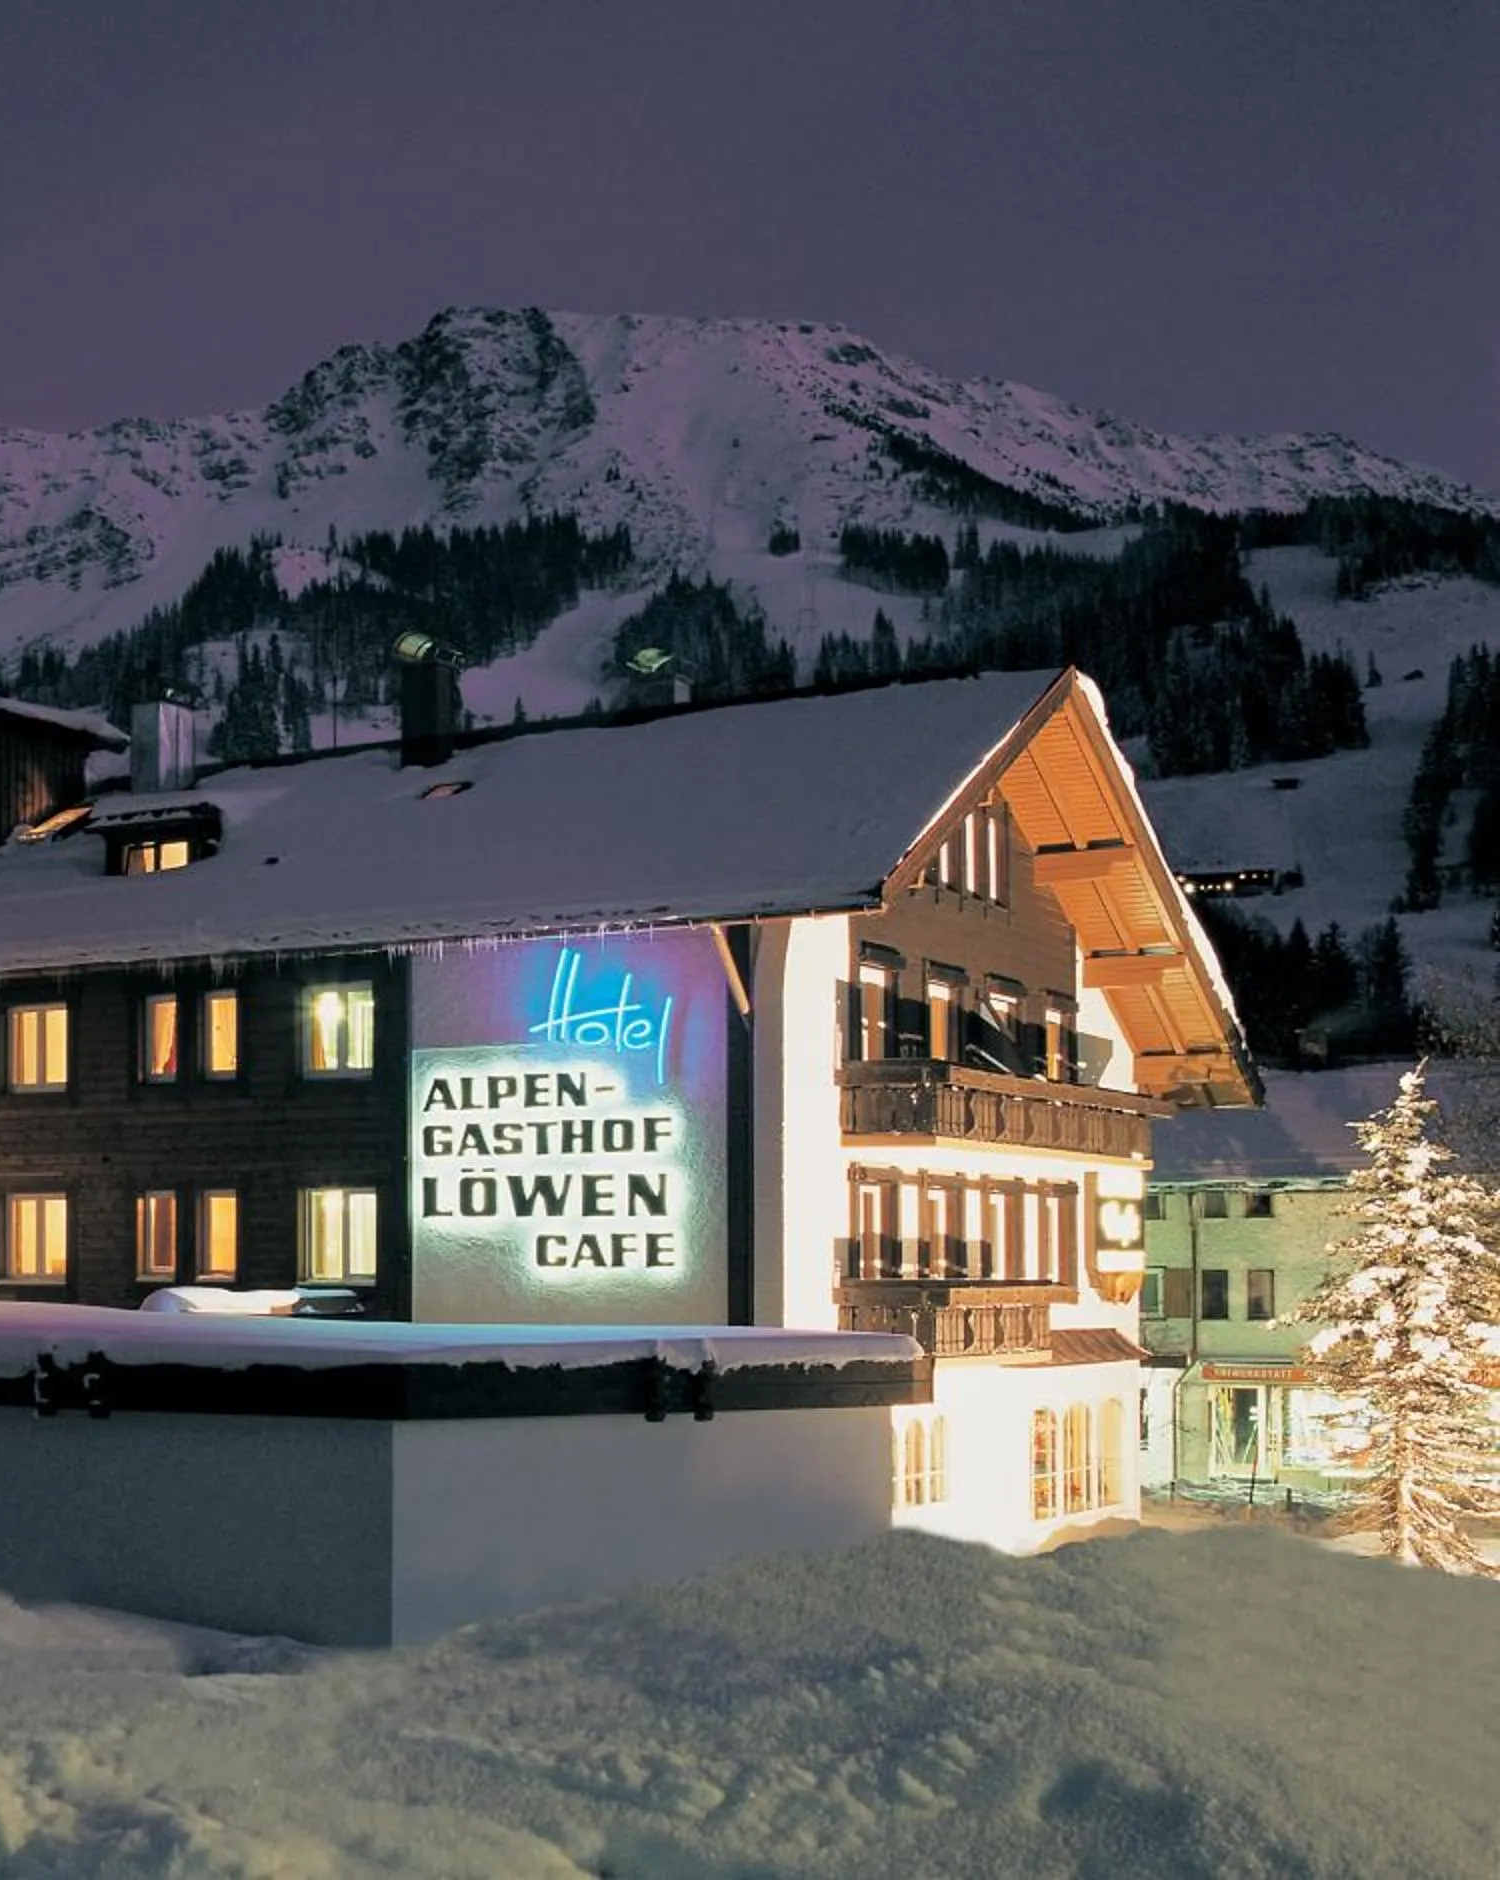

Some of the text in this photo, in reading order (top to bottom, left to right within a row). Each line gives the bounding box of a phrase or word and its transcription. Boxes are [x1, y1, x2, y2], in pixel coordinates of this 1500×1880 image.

[529, 949, 672, 1084] Hotel
[424, 1072, 615, 1112] ALPEN-
[423, 1118, 671, 1157] GASTHOF
[422, 1167, 668, 1218] LÖWEN
[536, 1233, 674, 1267] CAFE
